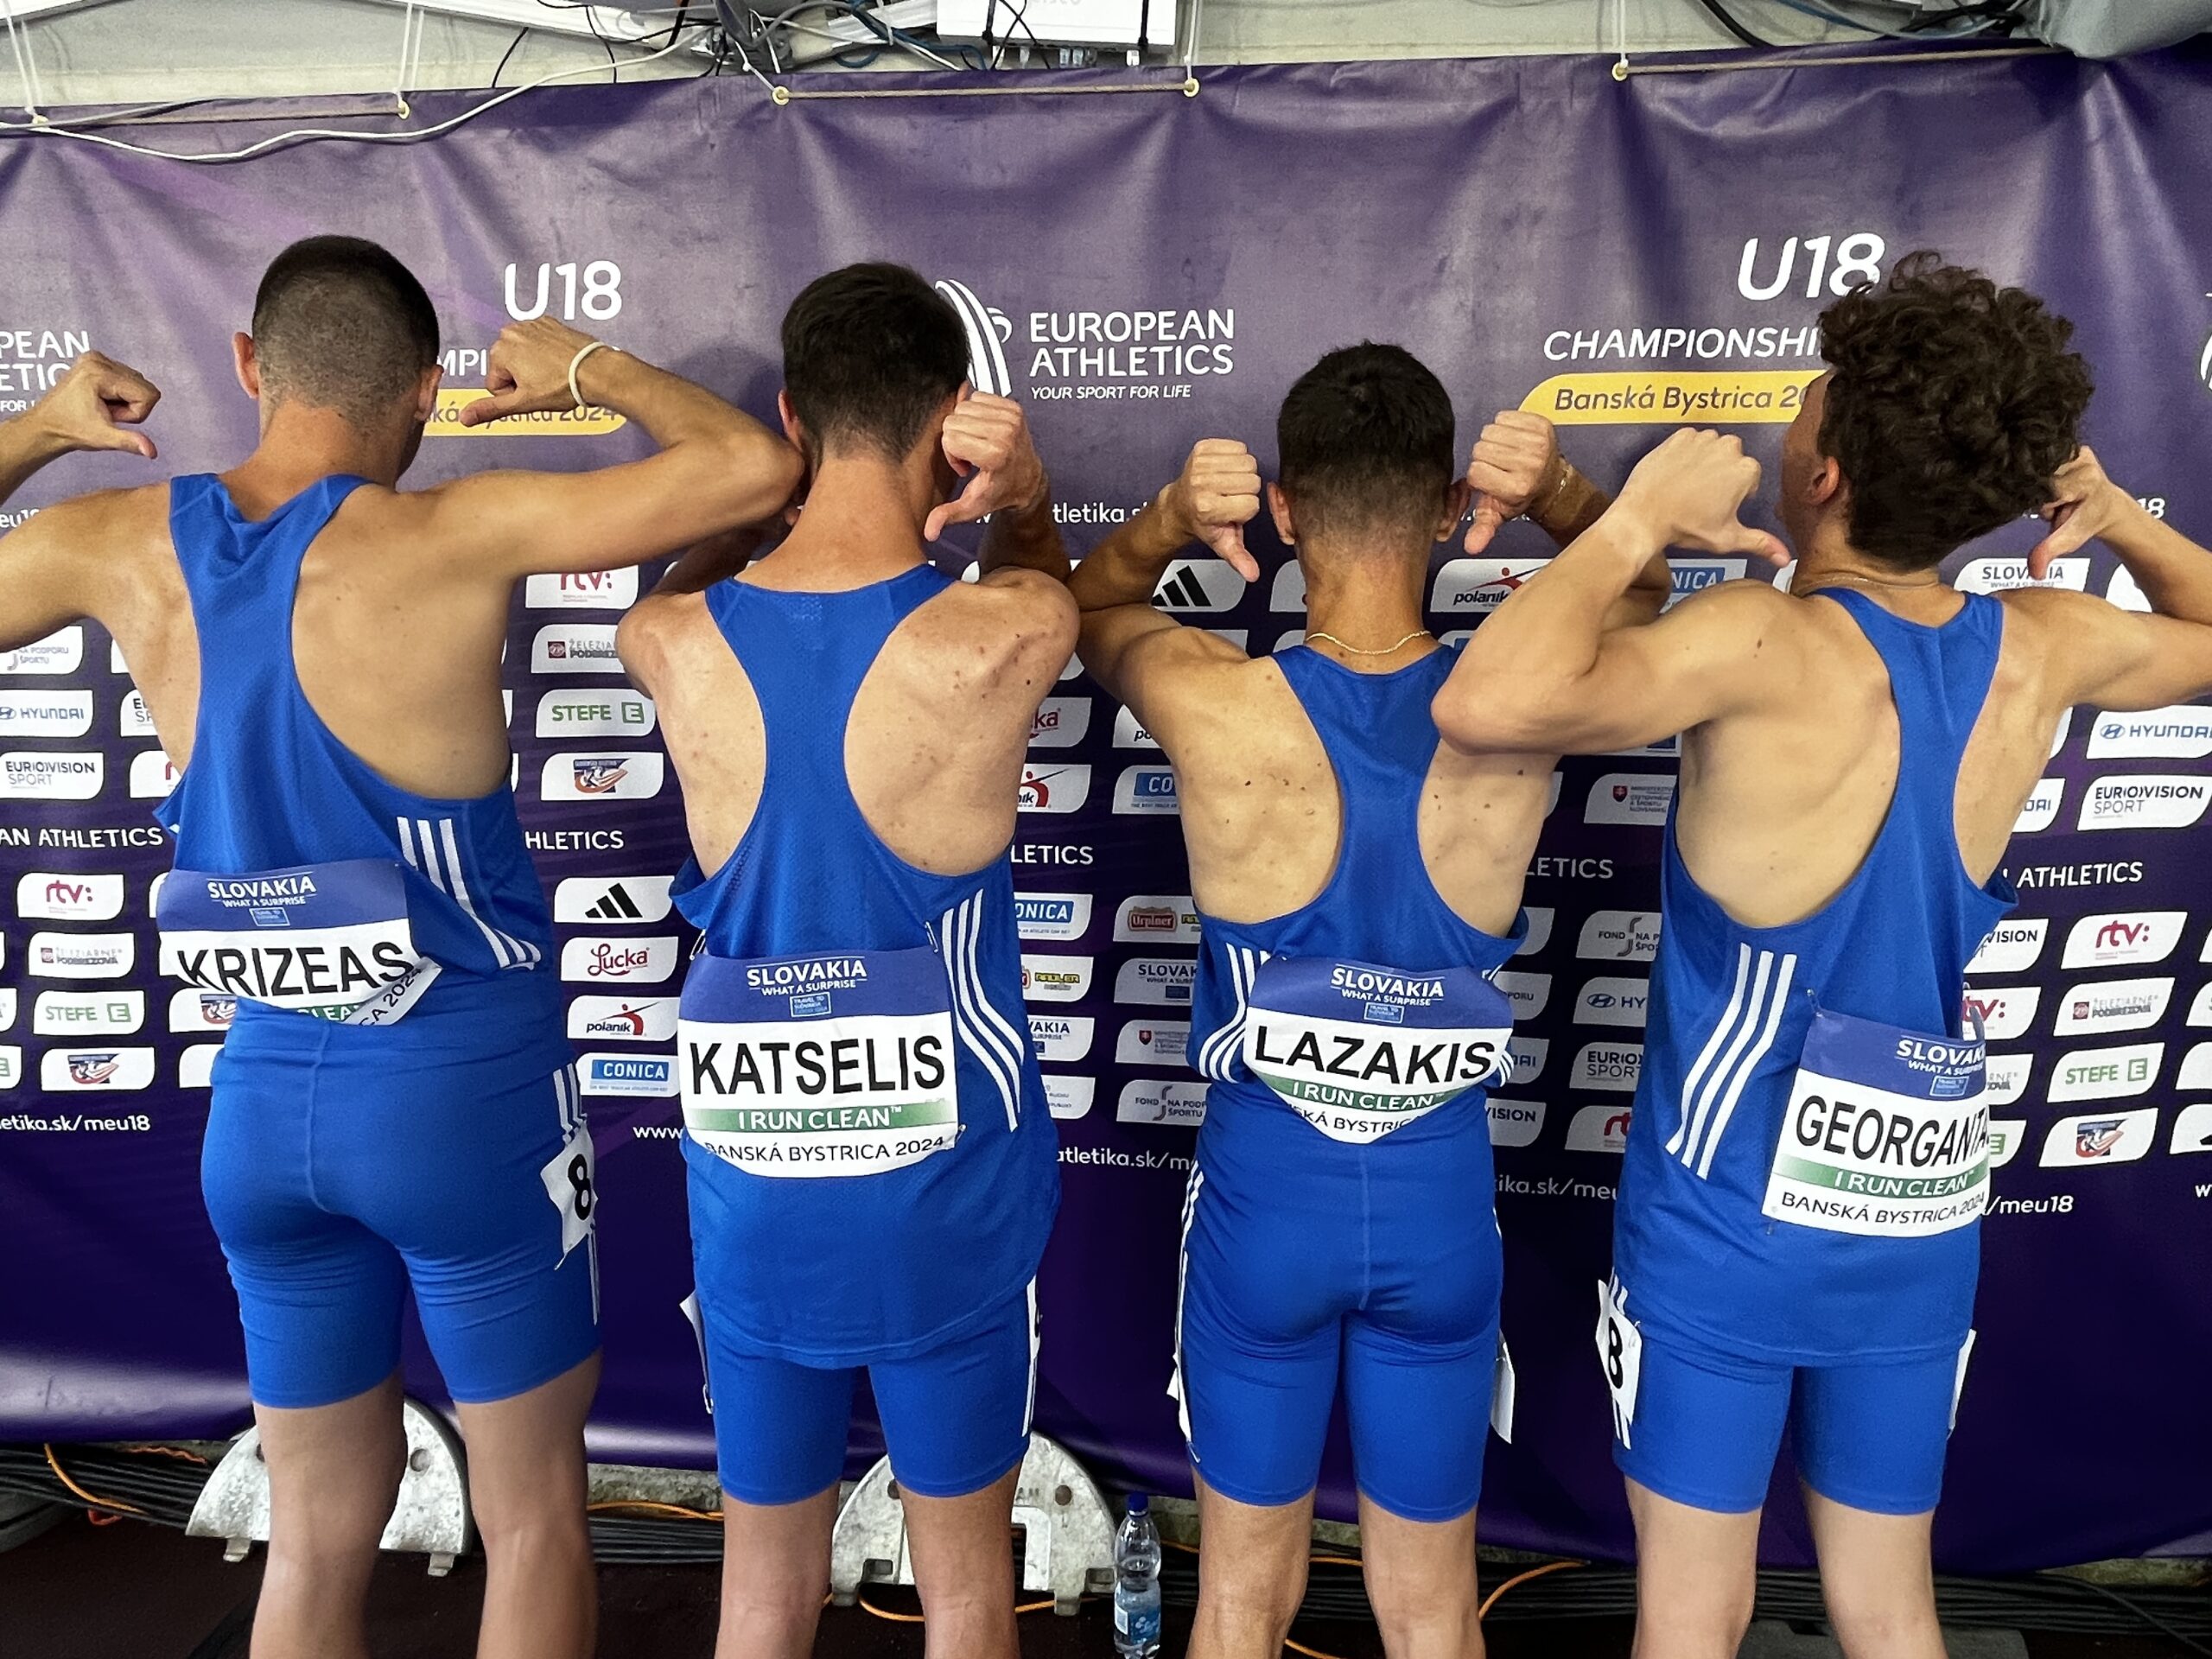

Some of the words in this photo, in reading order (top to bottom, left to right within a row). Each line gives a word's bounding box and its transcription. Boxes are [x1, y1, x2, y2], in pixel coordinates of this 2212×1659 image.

[1738, 232, 1885, 301] U18
[505, 260, 622, 321] U18
[1029, 308, 1234, 342] EUROPEAN
[1543, 327, 1822, 361] CHAMPIONSHI
[1029, 344, 1234, 377] ATHLETICS
[1031, 386, 1072, 399] YOUR
[1077, 385, 1126, 399] SPORT
[1129, 385, 1160, 398] FOR
[1163, 385, 1192, 398] LIFE
[1555, 385, 1654, 410] Banská
[1663, 385, 1772, 415] Bystrica
[1982, 566, 2063, 581] SLOVIA
[21, 707, 84, 720] HYUNDAI
[551, 705, 612, 721] STEFE
[9, 773, 52, 785] SPORT
[2094, 799, 2144, 815] SPORT
[39, 827, 163, 848] ATHLETICS
[524, 830, 624, 849] HLETICS
[2017, 861, 2143, 888] ATHLETICS
[207, 876, 316, 899] SLOVAKIA
[222, 898, 251, 908] WHAT
[261, 896, 306, 907] SURPRISE
[1599, 931, 1626, 940] FOND
[1636, 932, 1649, 941] NA
[177, 942, 415, 997] KRIZEAS
[588, 943, 649, 976] Lucka
[747, 959, 867, 986] SLOVAKIA
[1332, 966, 1444, 997] SLOVAKIA
[383, 968, 423, 1007] 2024
[761, 985, 794, 996] WHAT
[796, 985, 804, 994] A
[806, 979, 856, 993] SURPRISE
[1342, 988, 1372, 1001] WHAT
[1374, 993, 1382, 1002] A
[1383, 994, 1432, 1007] SURPRISE
[46, 1006, 98, 1021] STEFE
[586, 1020, 632, 1033] polanik
[690, 1036, 946, 1095] KATSELIS
[1255, 1026, 1495, 1084] LAZAKIS
[1908, 1059, 1944, 1074] WHAT
[1944, 1066, 1952, 1076] A
[603, 1063, 665, 1078] CONICA
[2065, 1065, 2119, 1084] STEFE
[1135, 1096, 1159, 1106] FOND
[1294, 1082, 1299, 1096] I
[1305, 1084, 1354, 1107] RUN
[738, 1112, 744, 1129] I
[750, 1110, 804, 1130] RUN
[1796, 1096, 1989, 1167] GEORGANTA
[790, 1142, 890, 1161] BYSTRICA
[895, 1136, 944, 1156] 2024
[568, 1154, 592, 1221] 8
[1834, 1171, 1842, 1187] I
[1847, 1173, 1903, 1196] RUN
[1782, 1192, 1869, 1222] BANSKÁ
[1875, 1205, 1957, 1224] BYSTRICA
[1609, 1316, 1624, 1389] 8
